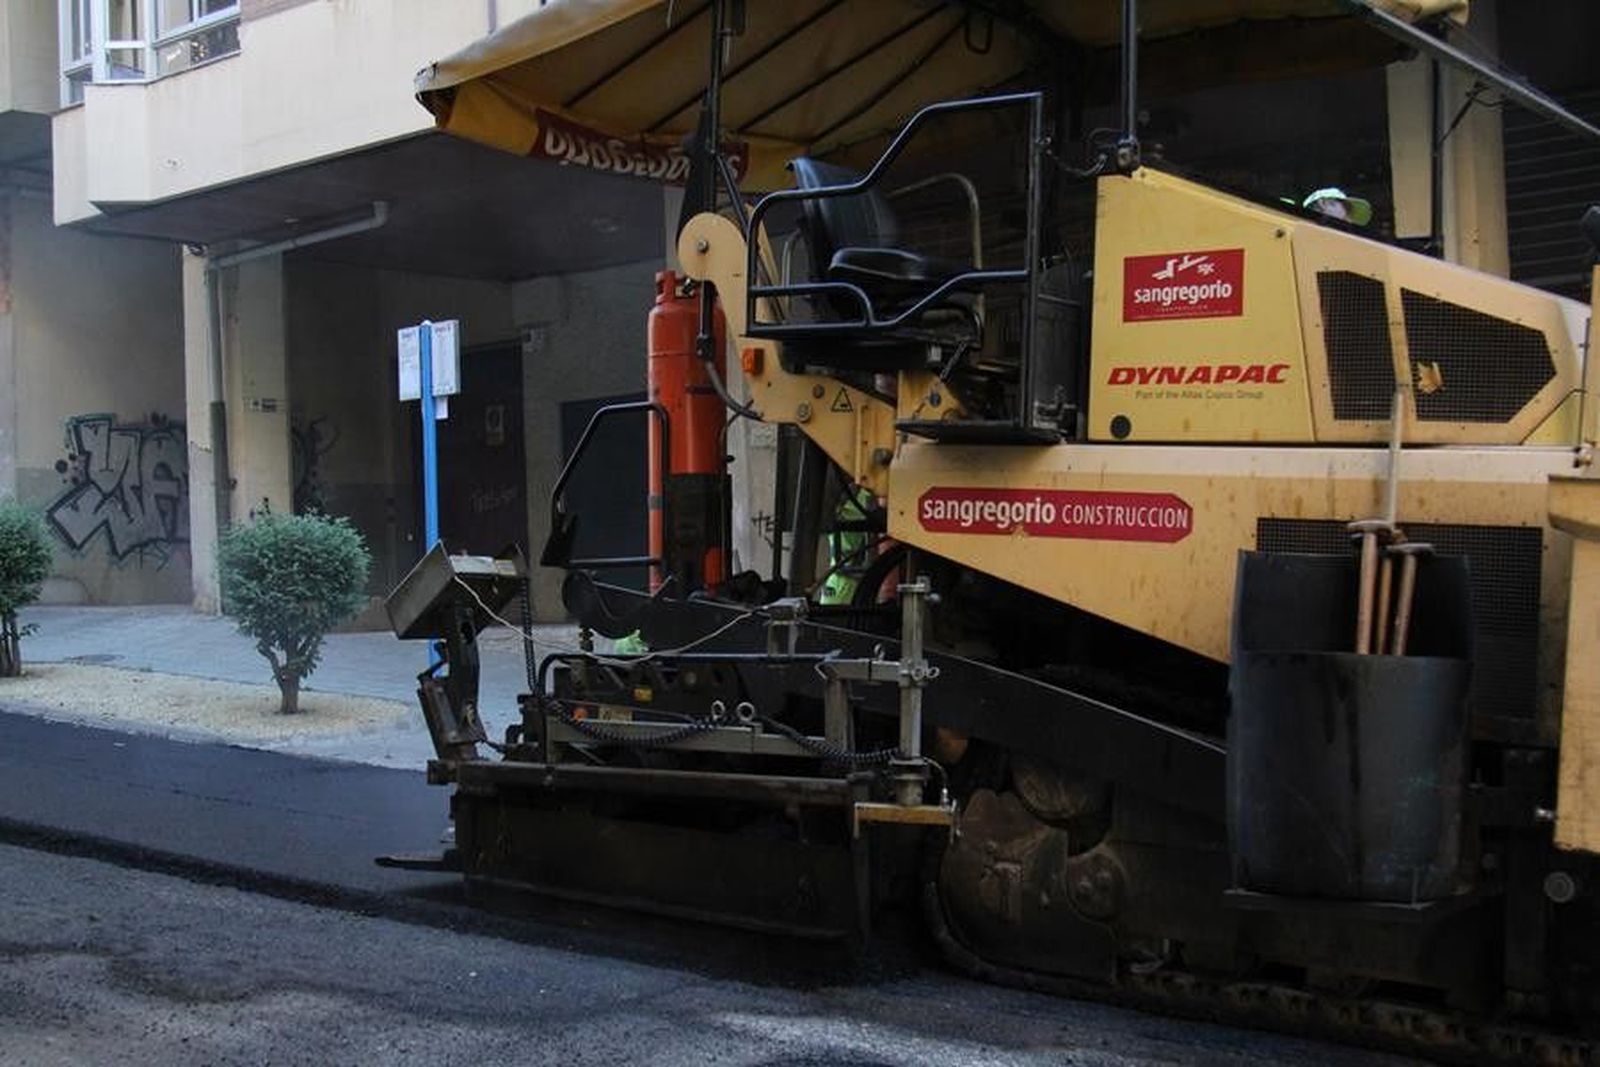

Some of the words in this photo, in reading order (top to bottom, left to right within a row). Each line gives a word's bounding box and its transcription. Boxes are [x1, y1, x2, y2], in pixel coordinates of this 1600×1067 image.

[1134, 280, 1232, 304] sangregorio
[1107, 364, 1291, 385] DYNAPAC
[923, 497, 1056, 528] sangregorio
[1062, 503, 1188, 529] CONSTRUCCION
